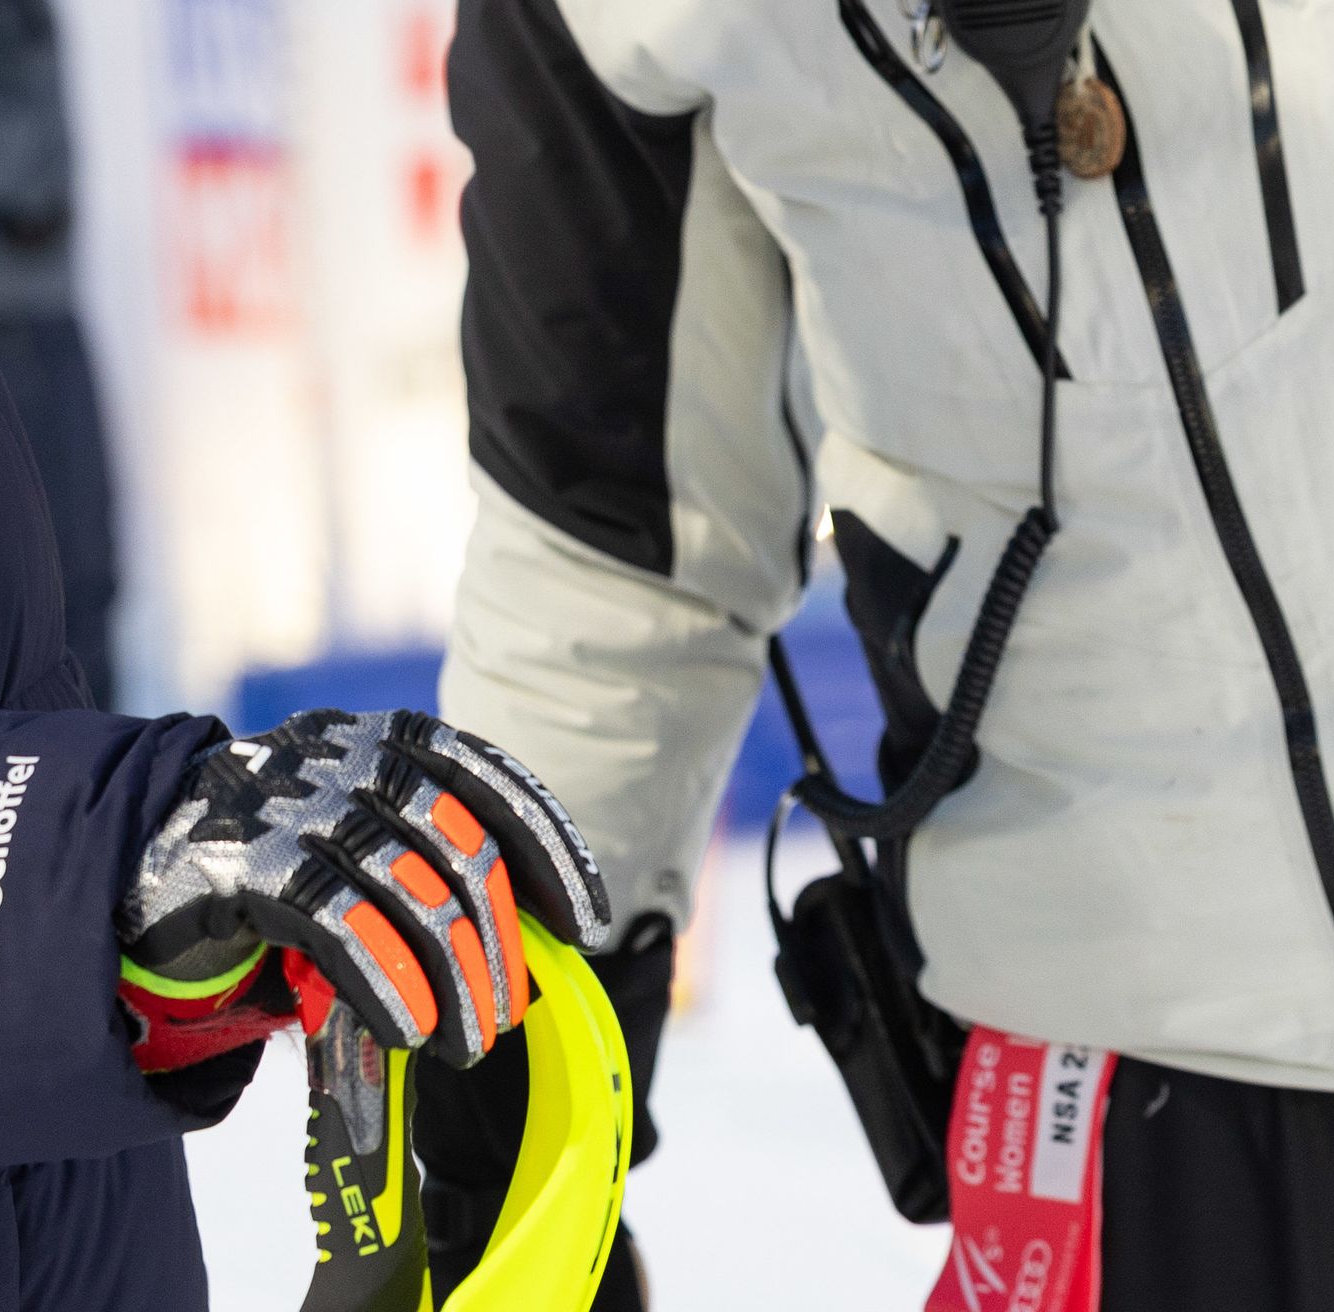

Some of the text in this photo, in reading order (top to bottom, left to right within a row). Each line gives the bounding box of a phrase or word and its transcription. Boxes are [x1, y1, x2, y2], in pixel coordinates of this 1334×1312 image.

[955, 1043, 1002, 1186] Course
[994, 1072, 1034, 1194] Women
[1052, 1045, 1089, 1144] NSA 2
[332, 1155, 380, 1256] LEKI
